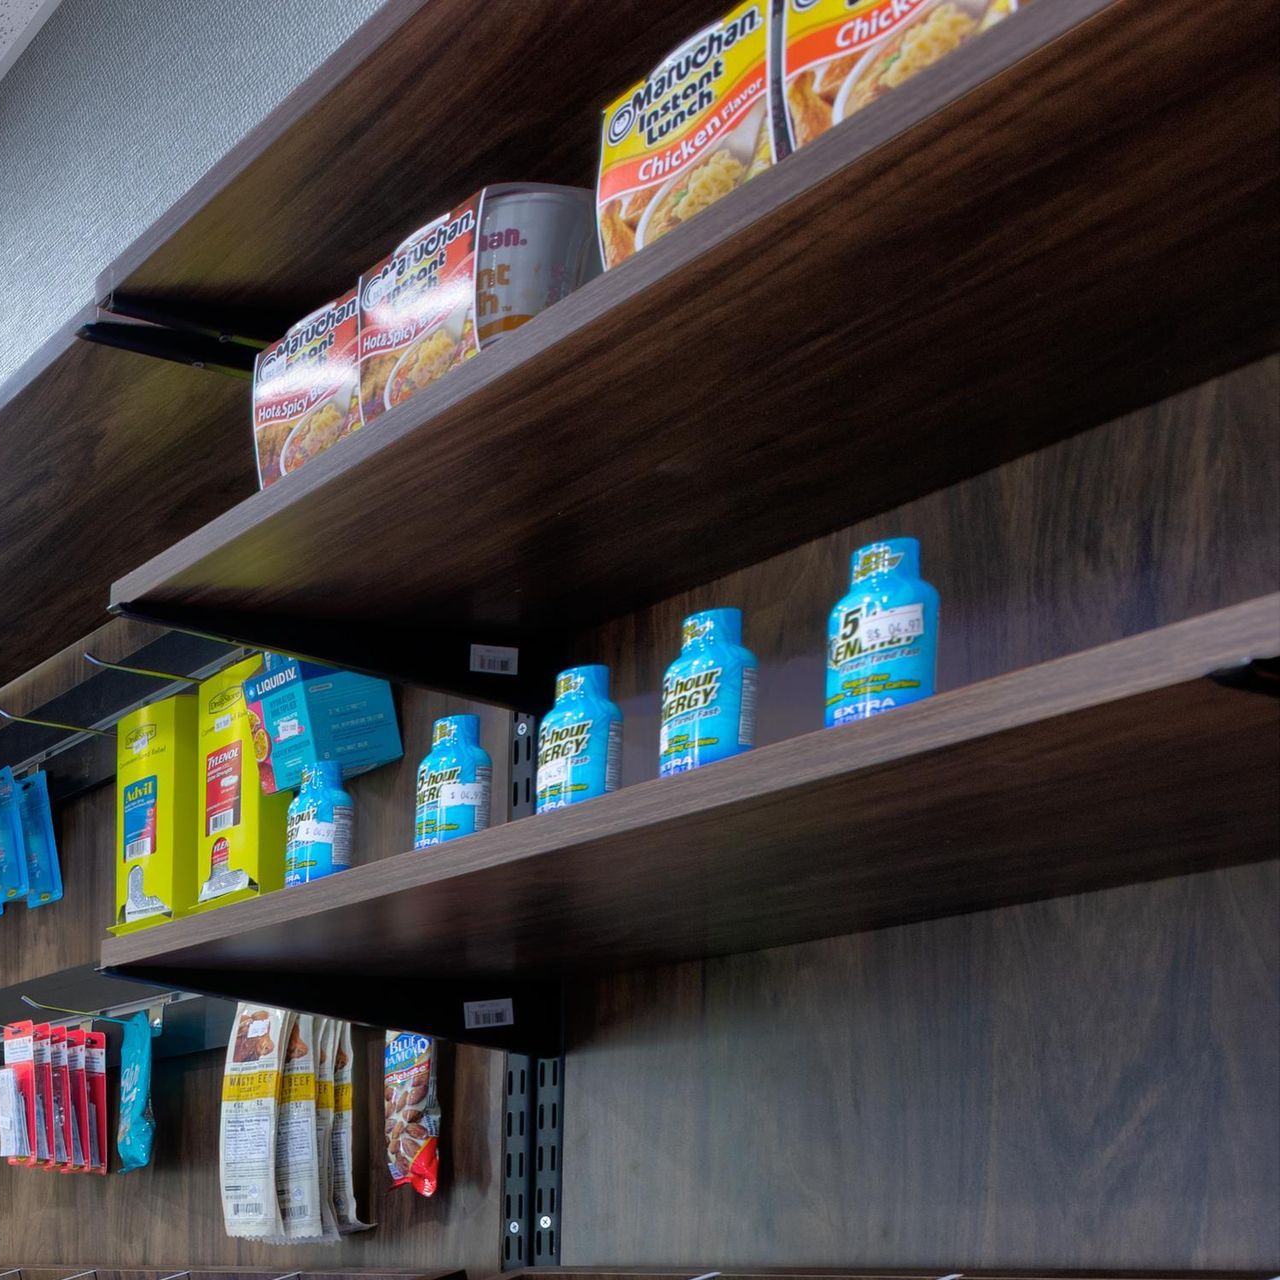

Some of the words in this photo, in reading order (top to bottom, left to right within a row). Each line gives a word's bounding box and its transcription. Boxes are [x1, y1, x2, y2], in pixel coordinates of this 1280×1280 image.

[630, 7, 756, 112] Maruchan
[638, 60, 723, 133] Instant
[638, 116, 721, 182] Chicken
[721, 77, 764, 120] Flavor
[646, 90, 713, 145] Lunch
[276, 297, 357, 358] Maruchan
[256, 671, 285, 695] LIQUID
[833, 697, 896, 720] EXTRA
[206, 747, 240, 771] TYLENOL
[125, 780, 154, 802] Advil
[389, 1034, 416, 1055] BLUE
